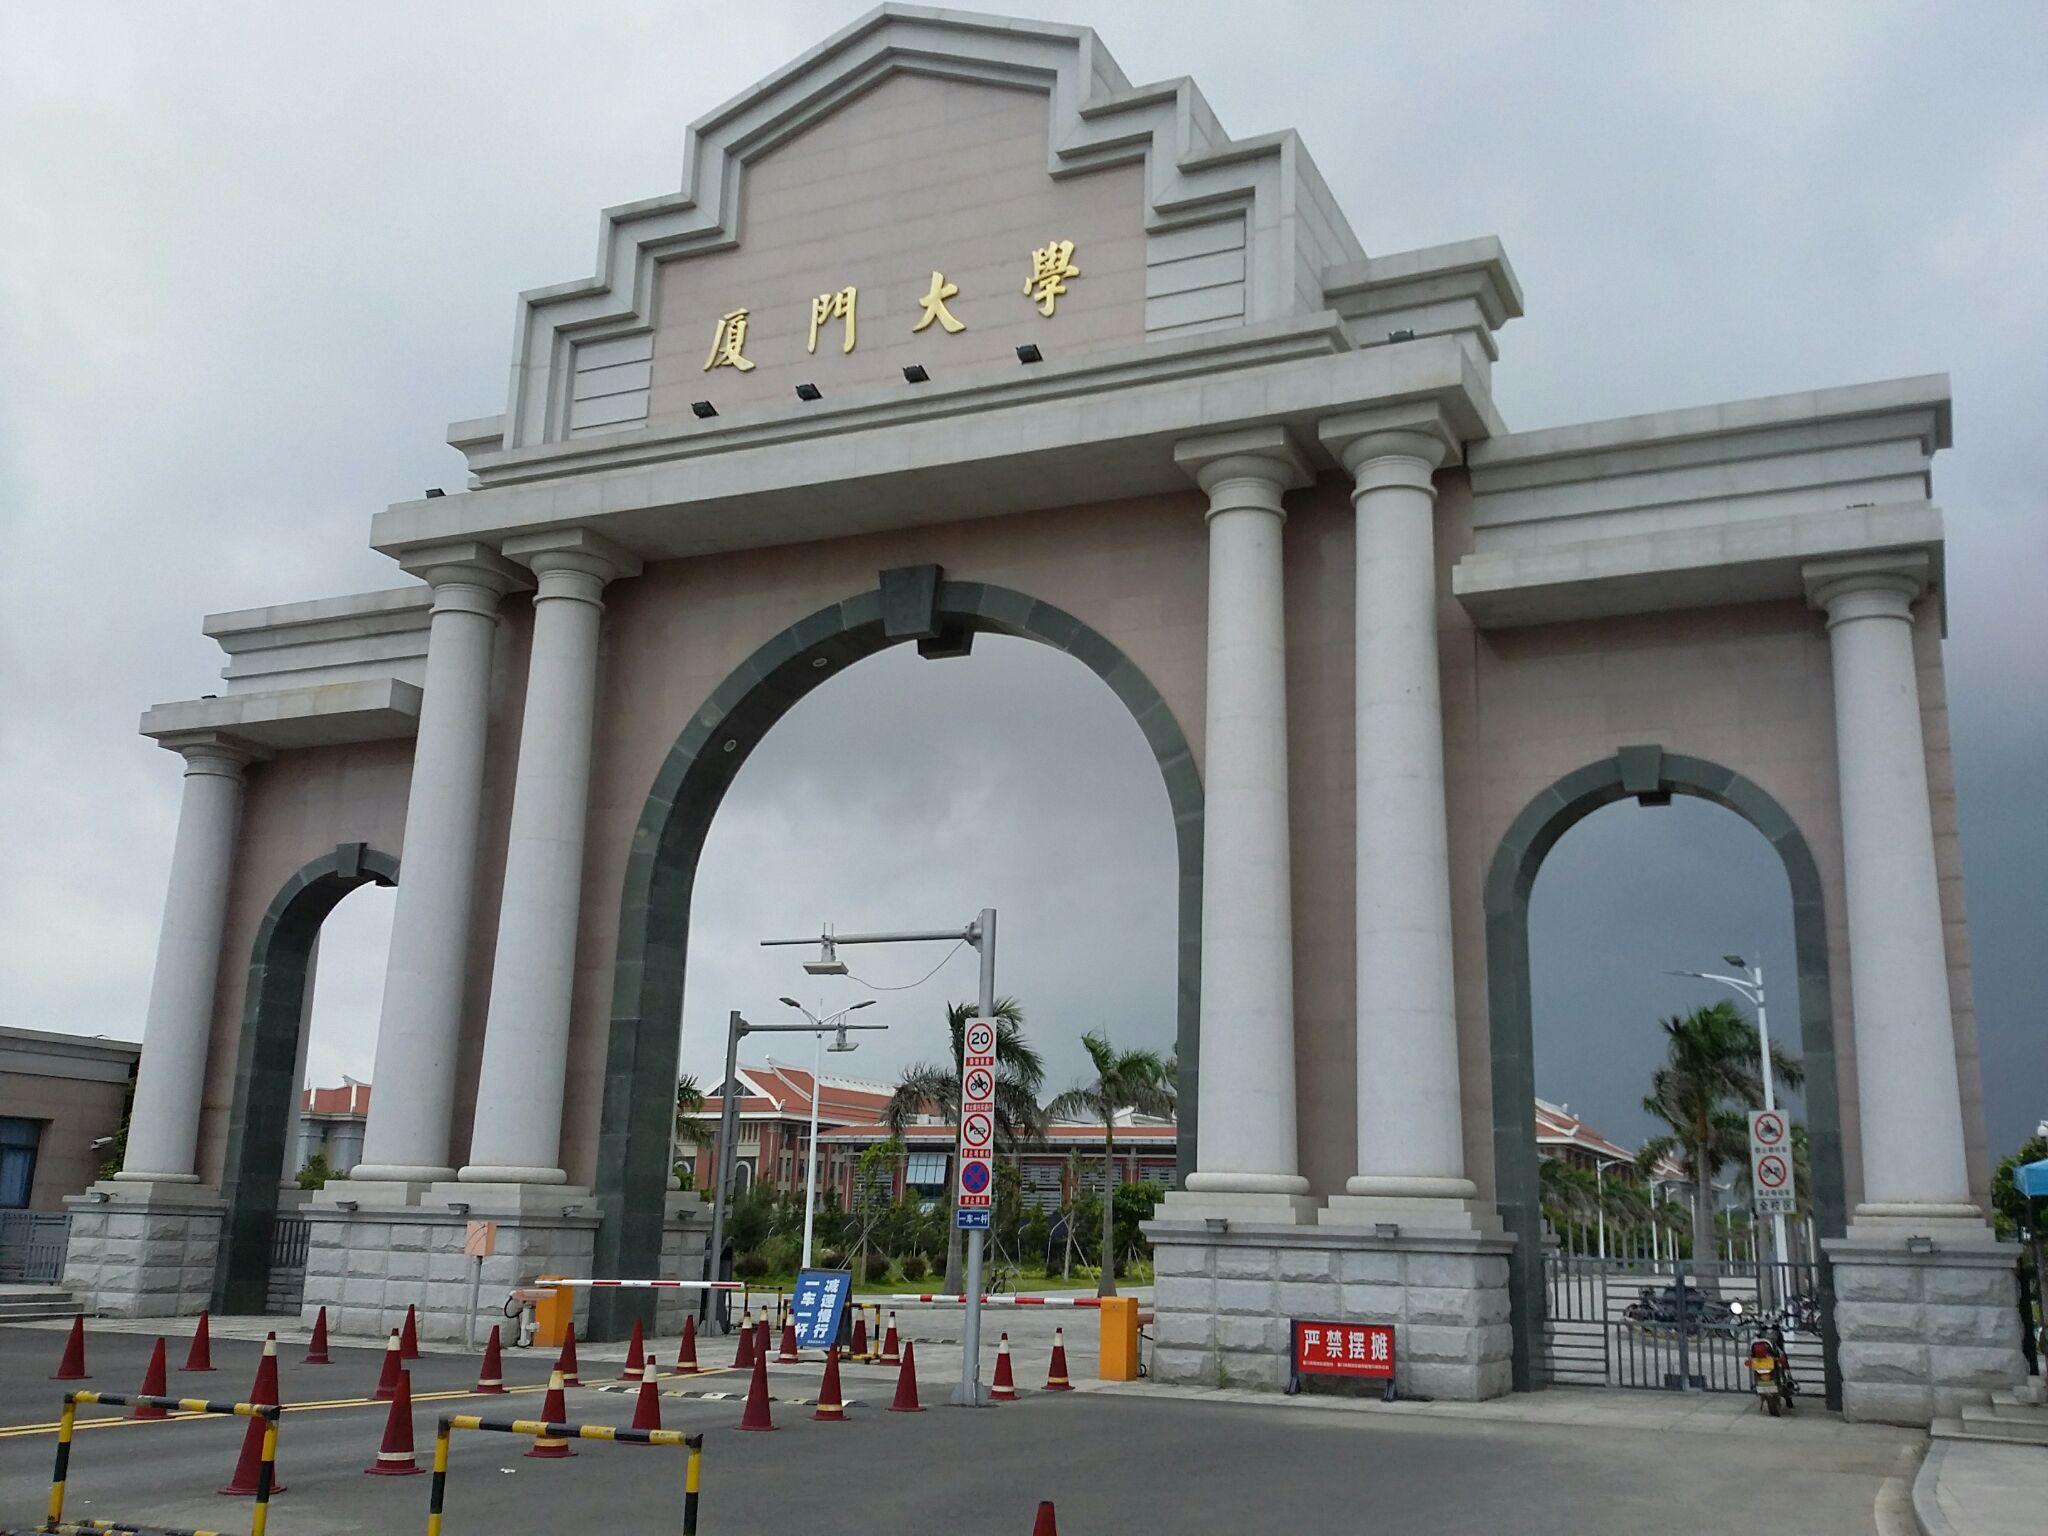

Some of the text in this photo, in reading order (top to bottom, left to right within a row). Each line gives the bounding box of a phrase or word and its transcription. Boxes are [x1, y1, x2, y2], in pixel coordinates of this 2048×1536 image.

[971, 1032, 989, 1045] 20
[959, 1213, 988, 1225] 一车一杆
[795, 1280, 820, 1338] 一车一杆
[1304, 1329, 1388, 1361] 严禁摆摊
